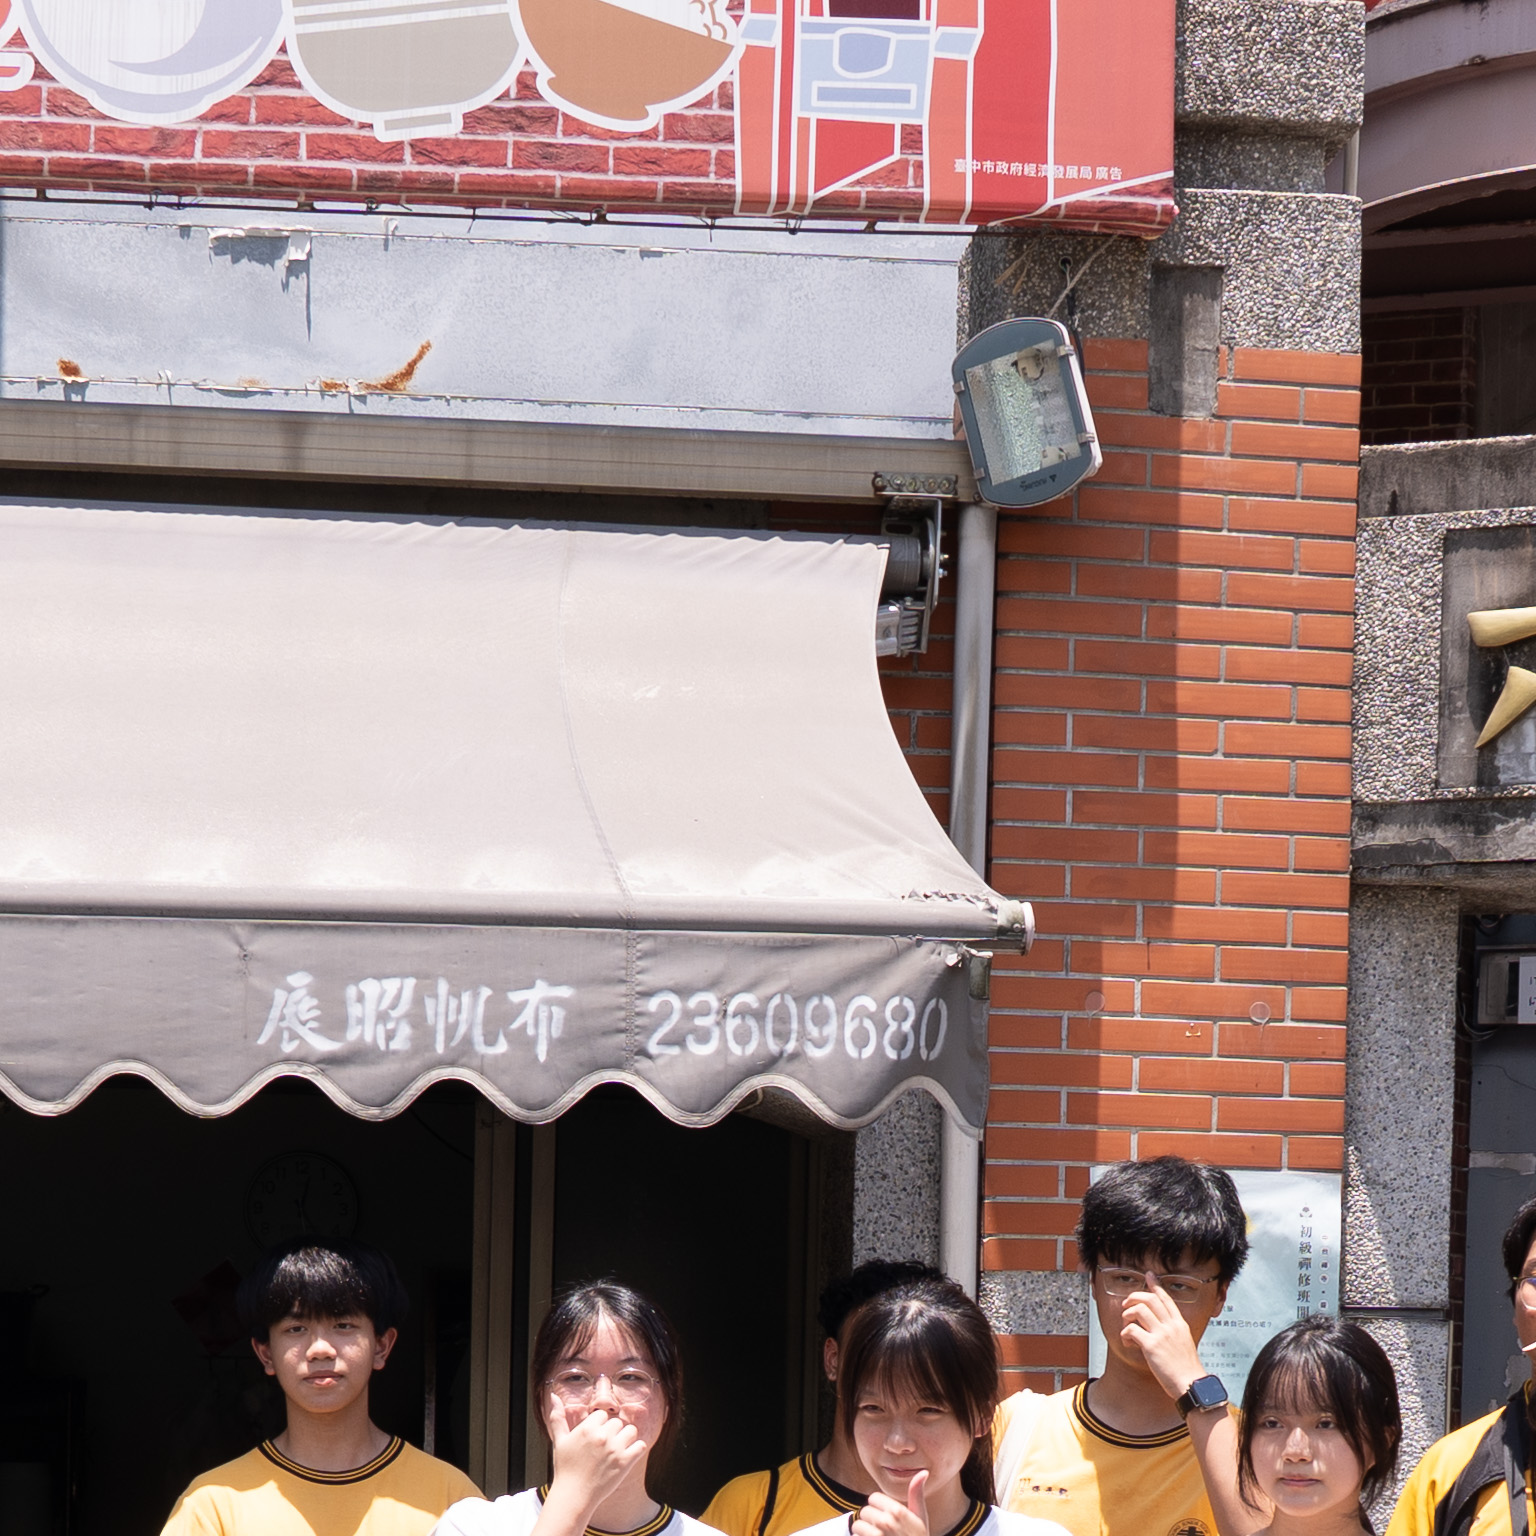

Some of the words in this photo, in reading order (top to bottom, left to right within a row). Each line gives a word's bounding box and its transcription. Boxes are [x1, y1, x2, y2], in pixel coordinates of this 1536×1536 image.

[1095, 166, 1123, 181] 廣告
[256, 971, 574, 1063] 展昭帆布
[647, 990, 948, 1062] 23609680
